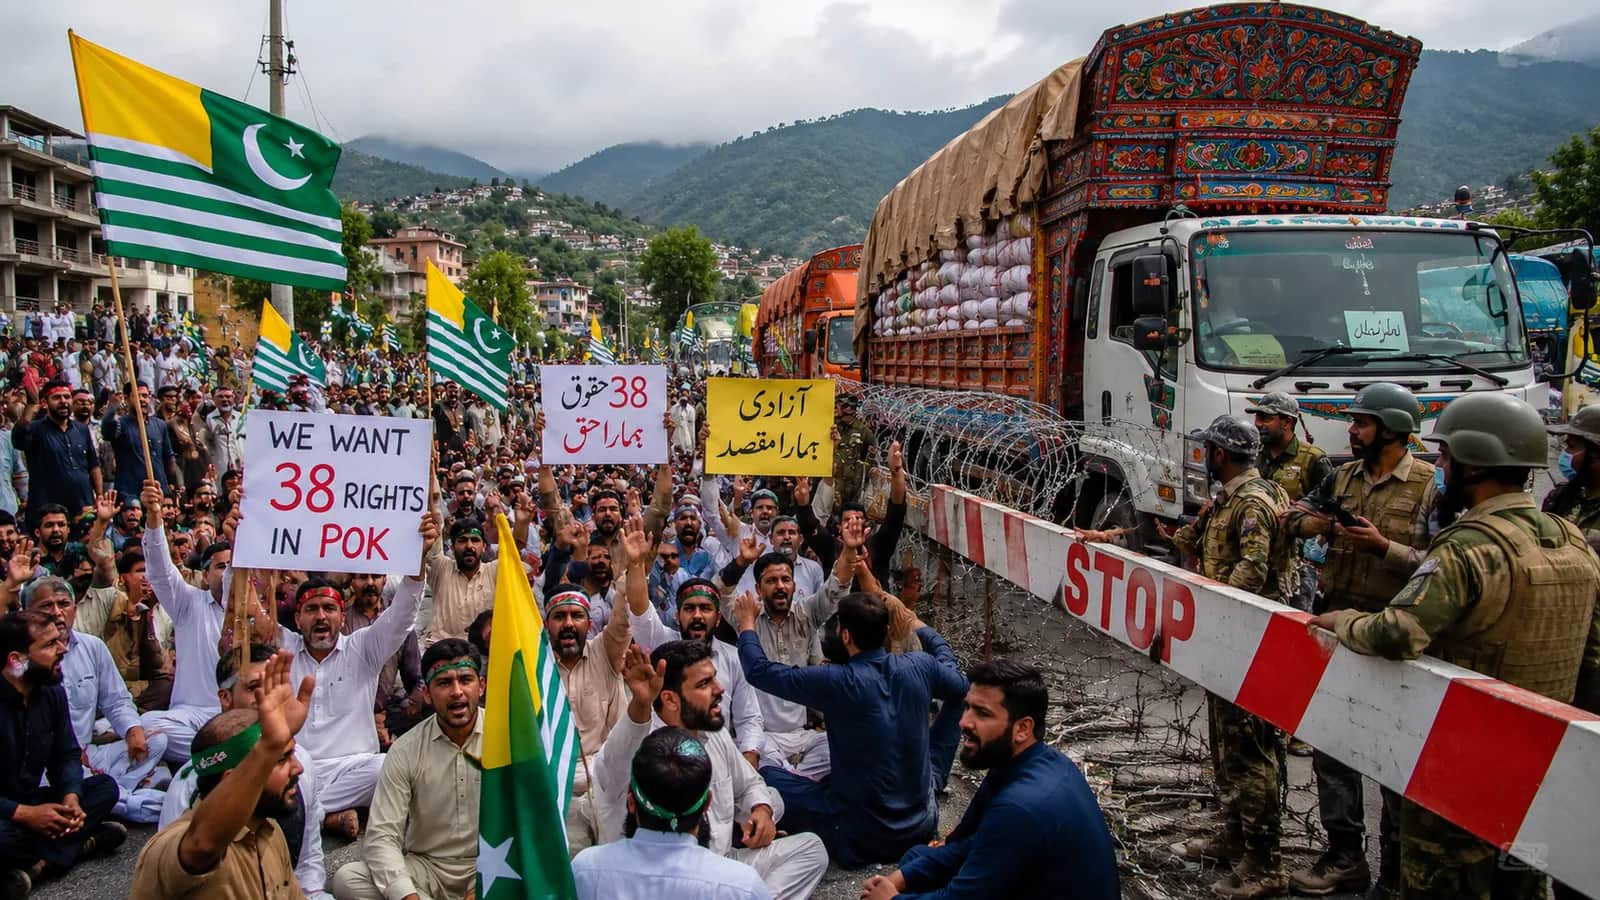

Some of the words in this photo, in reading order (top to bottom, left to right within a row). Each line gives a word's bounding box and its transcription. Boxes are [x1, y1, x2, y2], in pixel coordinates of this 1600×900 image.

[561, 375, 609, 410] حقوق
[609, 375, 648, 409] 38
[739, 384, 813, 421] آزادی
[268, 420, 315, 451] WE
[329, 425, 410, 456] WANT
[563, 416, 601, 454] حق
[603, 419, 644, 449] ہمارا
[715, 431, 776, 458] مقصد
[779, 431, 820, 460] ہمارا
[269, 461, 336, 514] 38
[343, 482, 425, 513] RIGHTS
[270, 527, 302, 556] IN
[319, 522, 391, 561] POK
[1063, 541, 1196, 664] STOP
